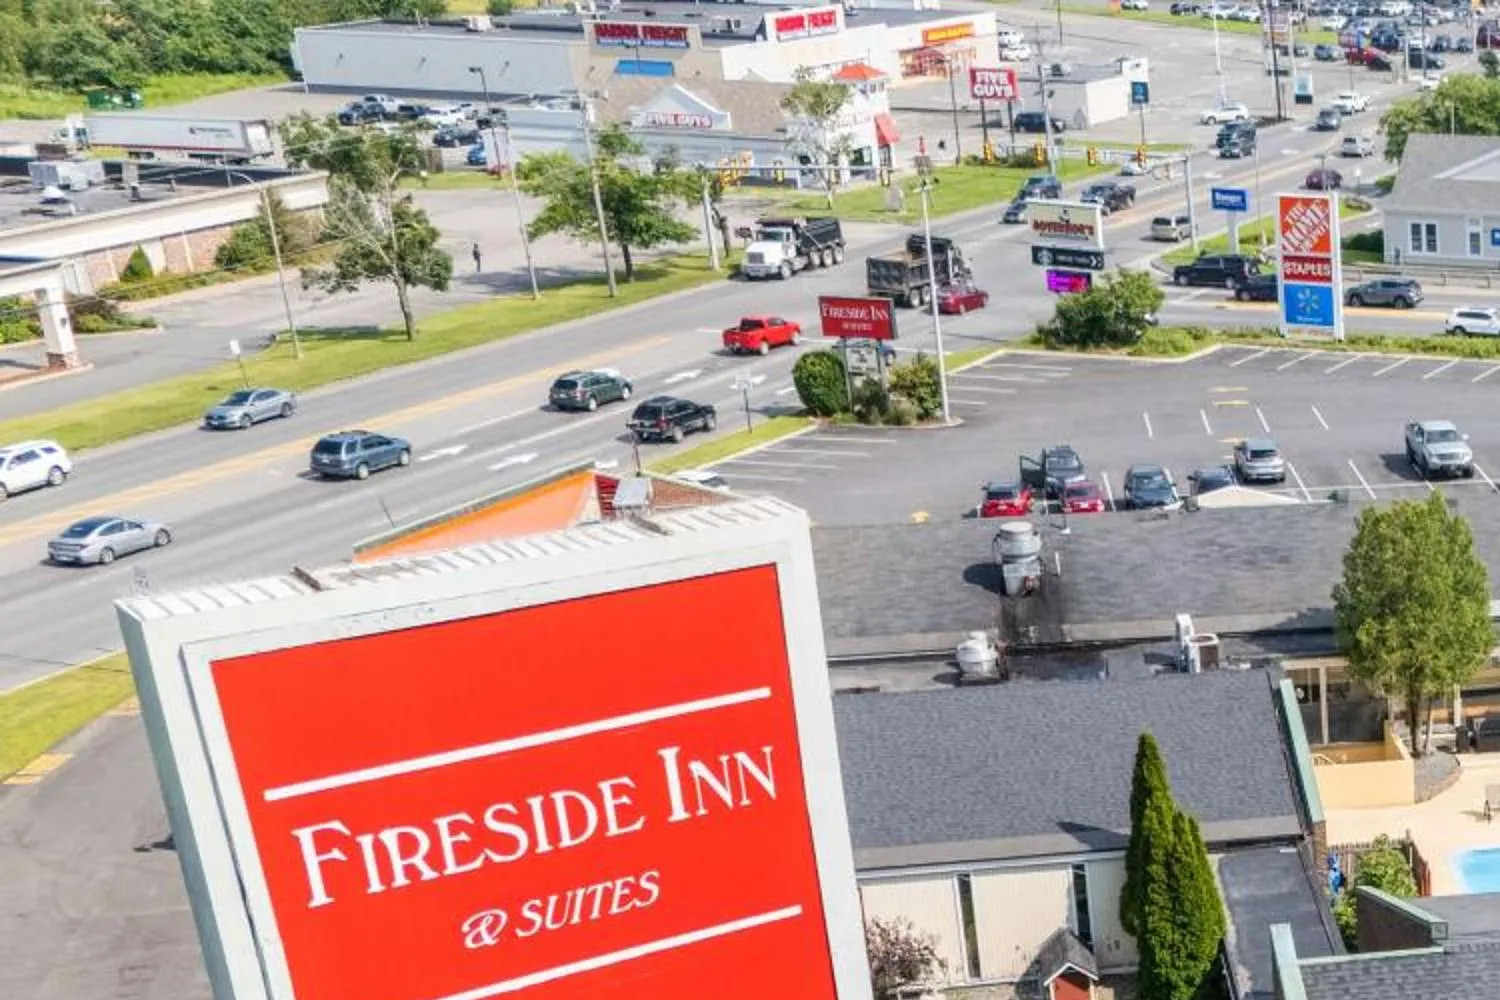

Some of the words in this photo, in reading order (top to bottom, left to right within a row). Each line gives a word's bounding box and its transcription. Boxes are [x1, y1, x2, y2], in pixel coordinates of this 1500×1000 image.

[976, 71, 1008, 84] FIVE
[974, 83, 1013, 97] GUYS
[1283, 262, 1331, 276] STAPLES
[822, 303, 866, 318] FIRESIDE
[291, 776, 645, 908] FIRESIDE
[658, 746, 777, 823] INN
[515, 870, 660, 938] SUITES
